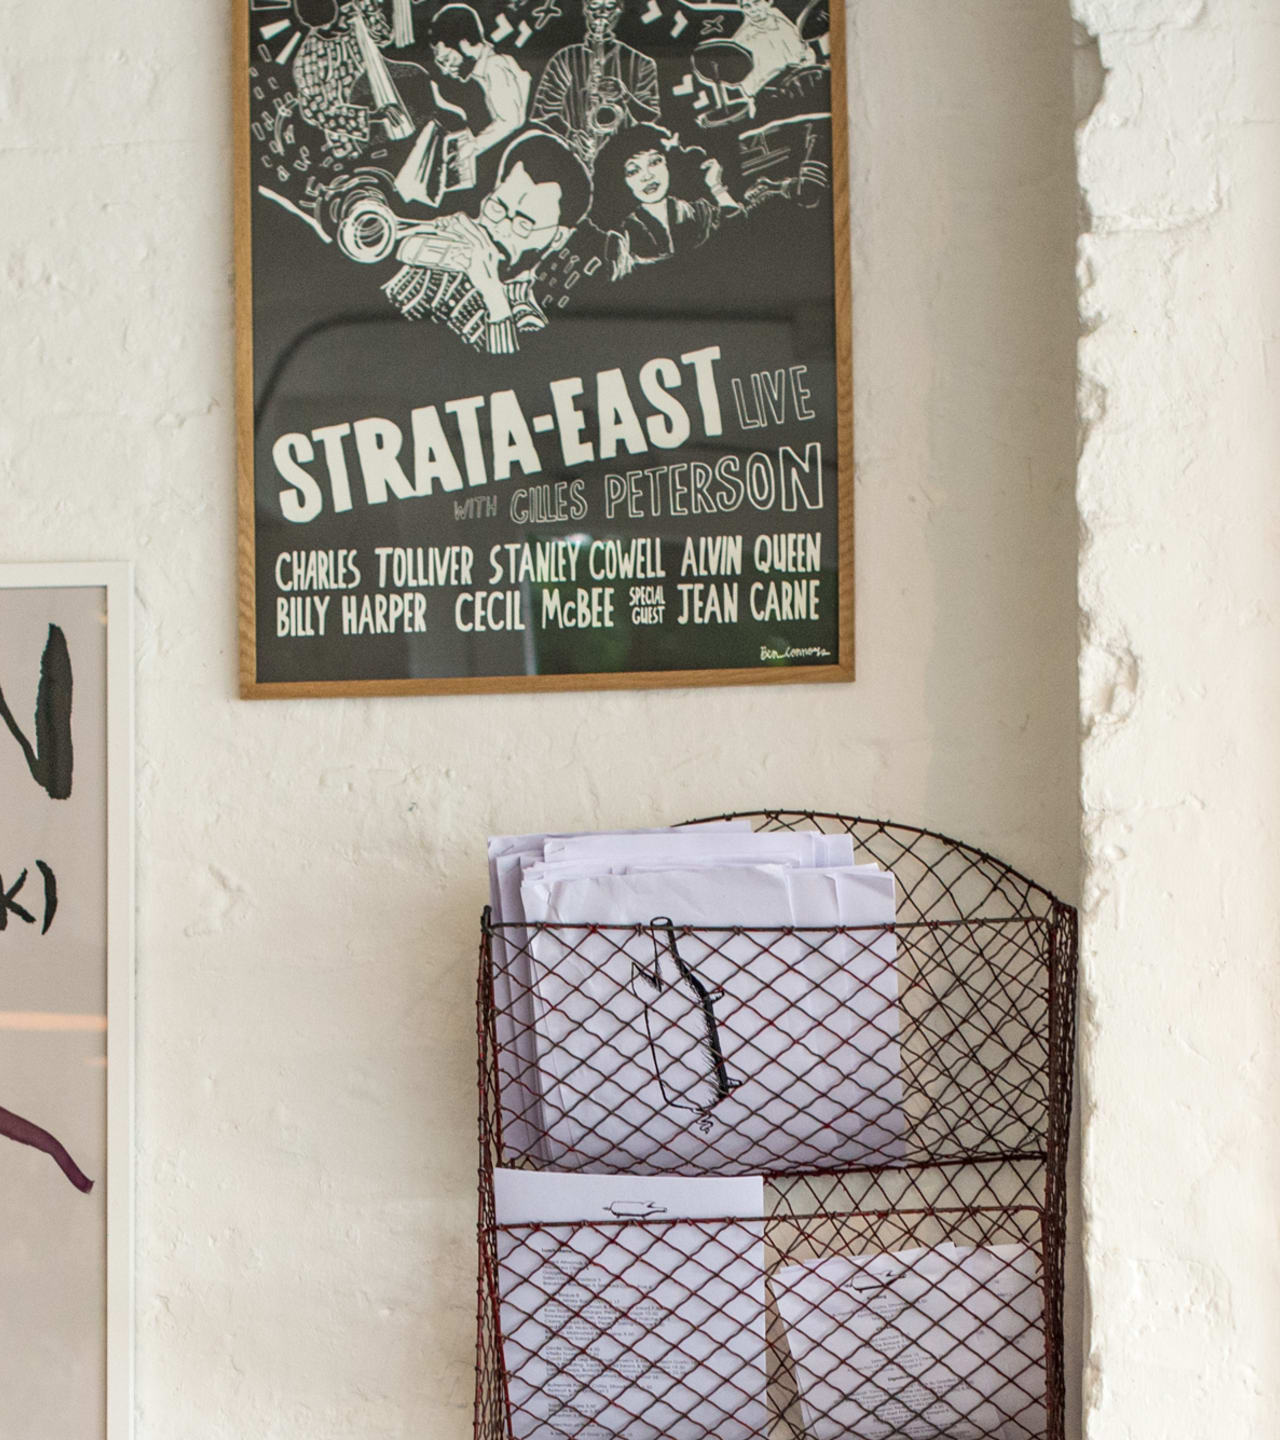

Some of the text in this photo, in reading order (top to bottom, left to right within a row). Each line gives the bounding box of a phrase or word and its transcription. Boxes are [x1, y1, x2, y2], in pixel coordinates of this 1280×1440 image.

[271, 345, 815, 525] STRATA-EAST LIVE
[453, 442, 824, 525] WITH GILLES PETERSON
[275, 532, 822, 593] CHARLES TOLLIVER STANLEY COWELL ALVIN QUEEN
[277, 578, 820, 638] BILLY HARPER CECIL McBEE JEAN CARNE
[628, 585, 666, 607] SPECIAL
[632, 604, 666, 626] GUEST
